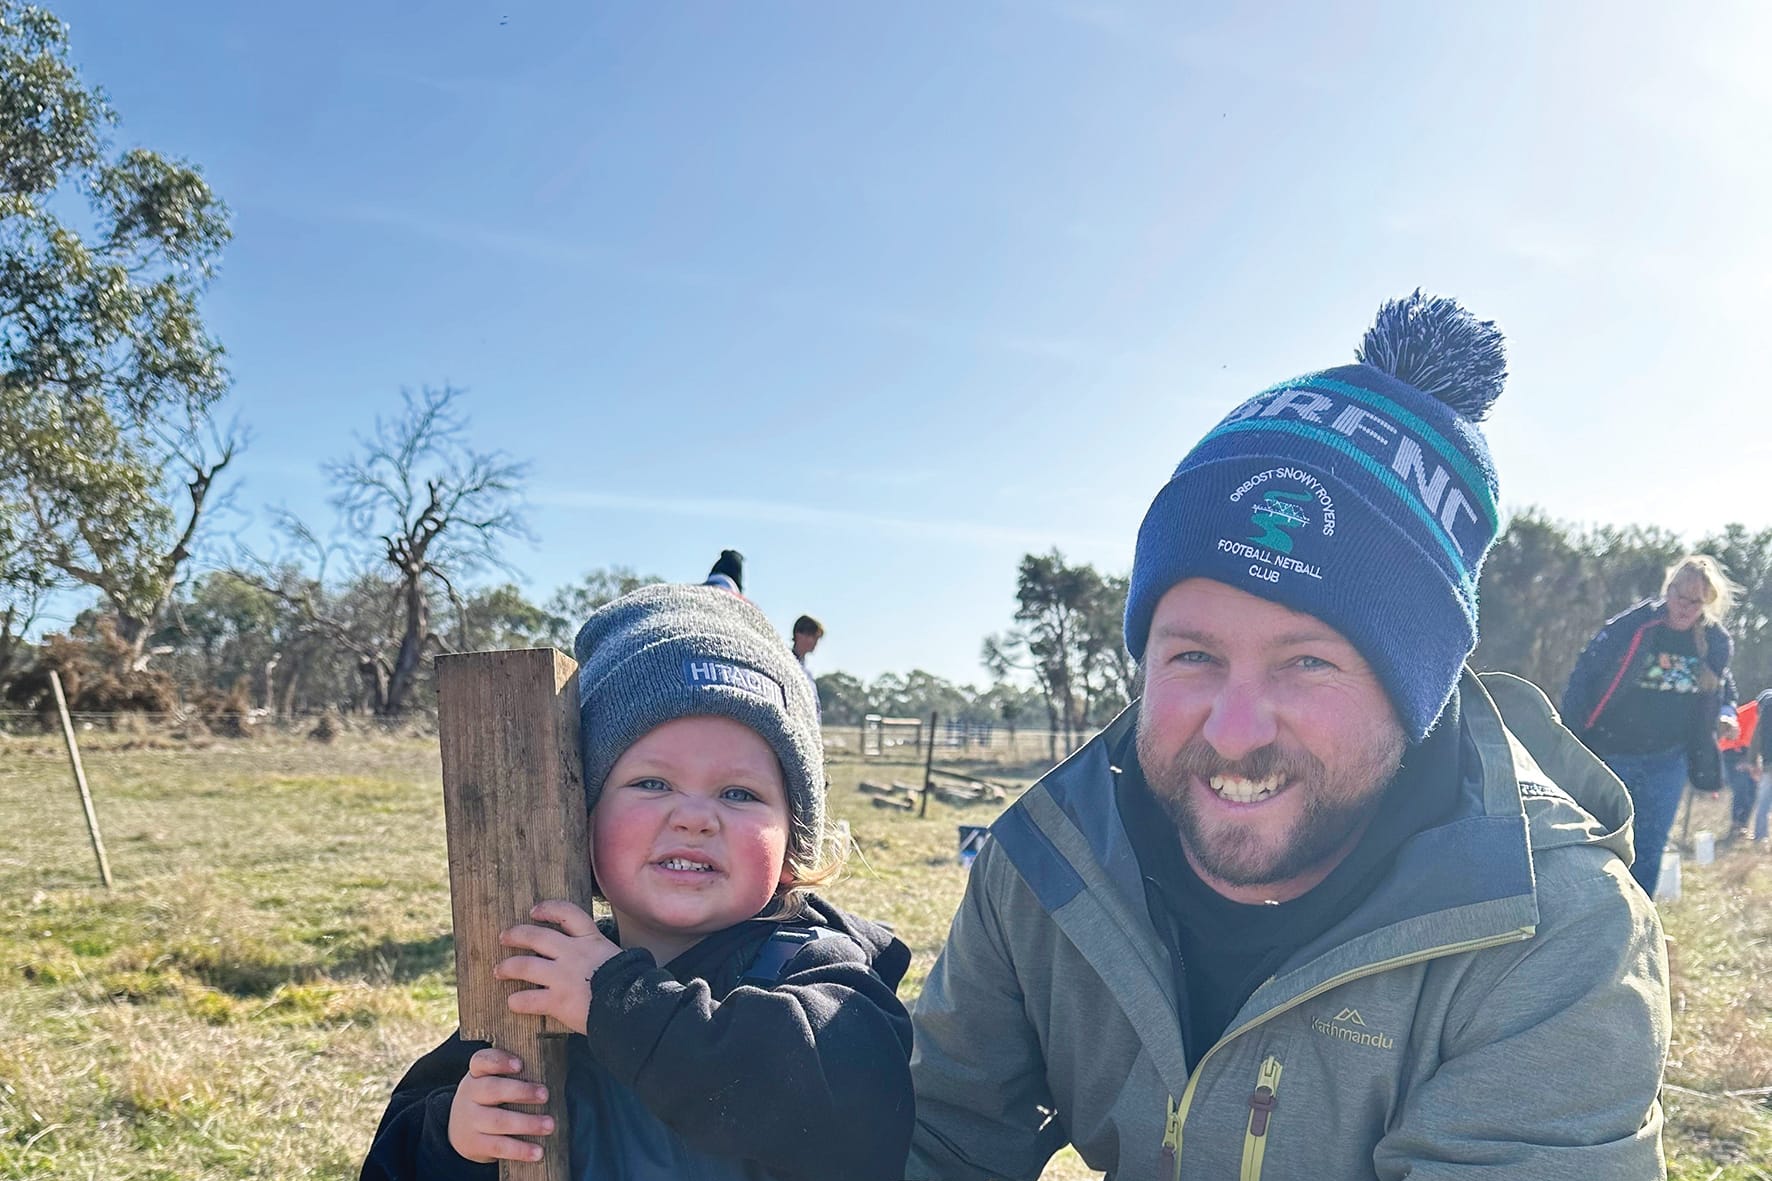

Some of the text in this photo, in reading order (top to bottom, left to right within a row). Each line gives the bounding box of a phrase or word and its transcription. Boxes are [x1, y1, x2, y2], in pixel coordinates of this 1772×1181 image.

[1230, 467, 1335, 537] ORBOST SNOWY ROVERS
[1217, 539, 1323, 580] FOOTBALL NETBALL
[1248, 564, 1280, 583] CLUB
[690, 662, 782, 703] HITACHI
[1311, 1015, 1394, 1049] Kathmandu
